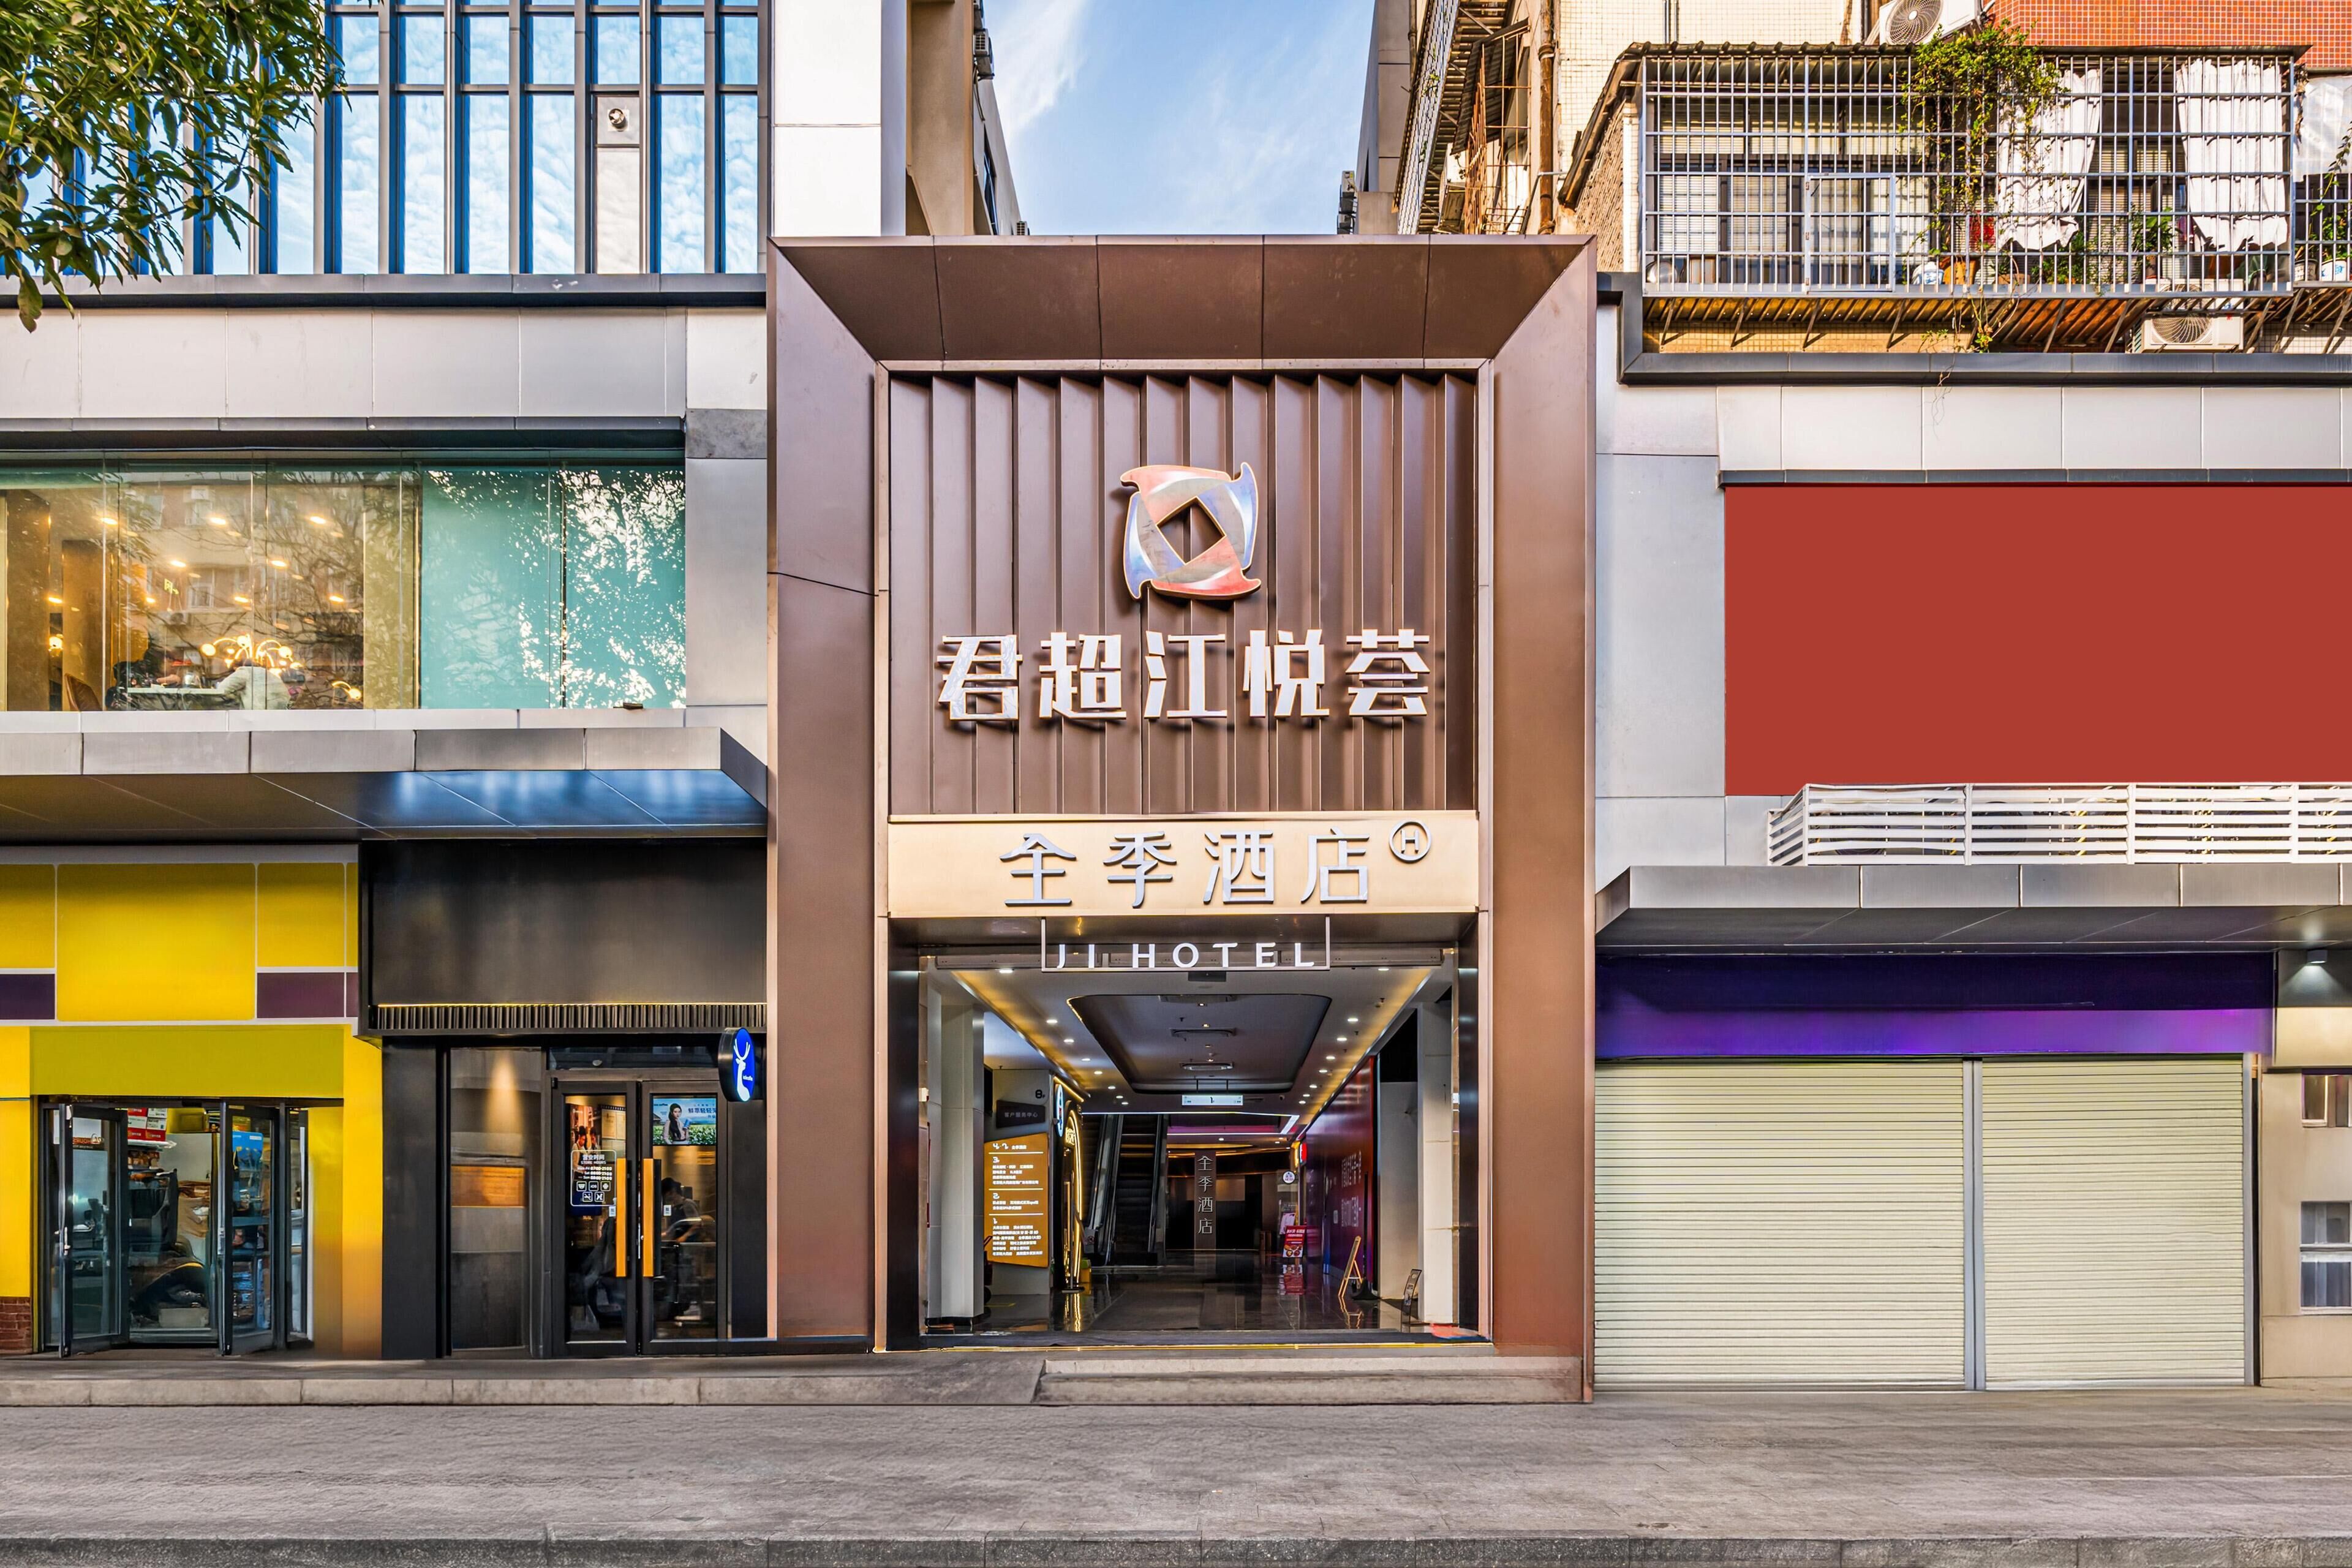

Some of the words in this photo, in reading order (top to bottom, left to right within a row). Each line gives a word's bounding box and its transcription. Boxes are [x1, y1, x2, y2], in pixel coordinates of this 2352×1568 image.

[936, 628, 1431, 721] 君超江悦荟
[999, 827, 1370, 908] 全季酒店
[1056, 943, 1095, 969] JI
[1132, 942, 1315, 968] HOTEL
[1197, 1155, 1213, 1234] 全季酒店
